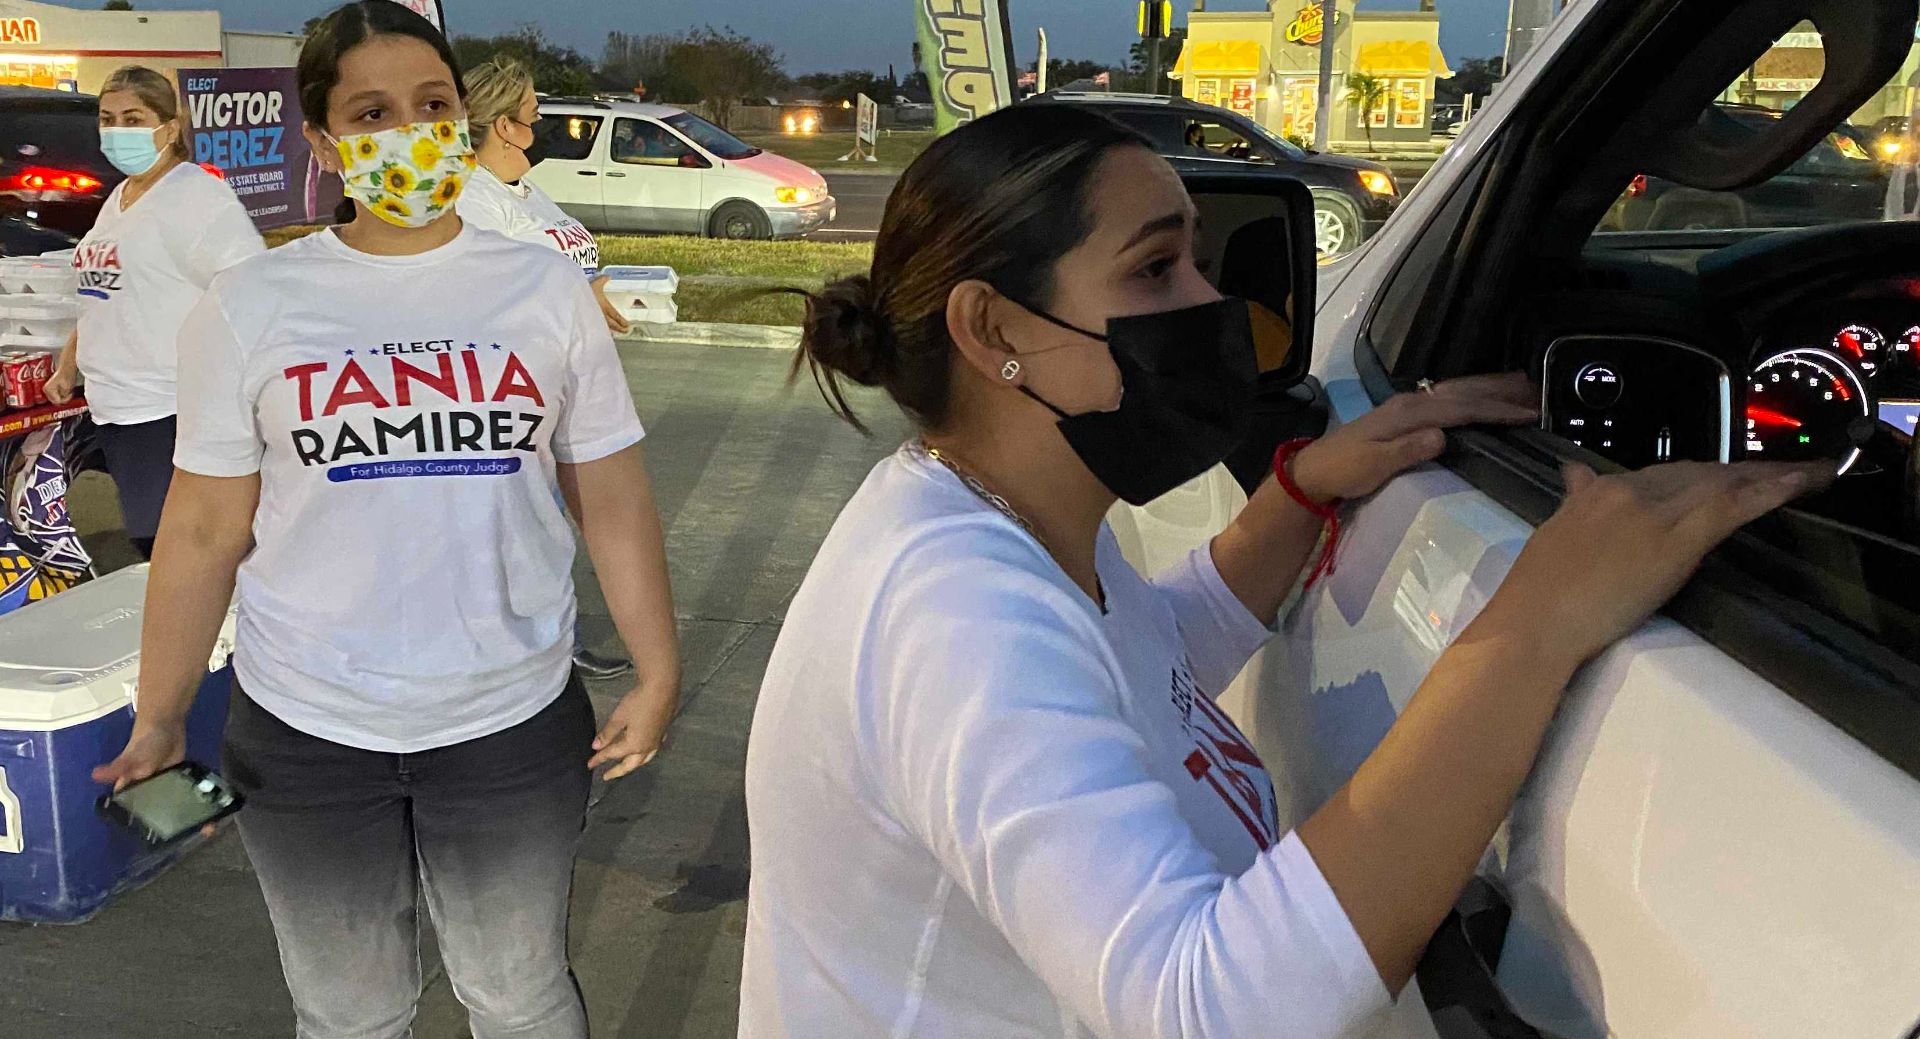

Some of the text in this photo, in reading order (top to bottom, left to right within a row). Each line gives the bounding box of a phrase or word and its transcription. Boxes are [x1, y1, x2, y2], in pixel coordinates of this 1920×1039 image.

[187, 78, 218, 91] ELECT
[188, 91, 283, 129] VICTOR
[194, 126, 285, 170] PEREZ
[236, 173, 258, 186] STATE
[259, 170, 284, 183] BOARD
[254, 183, 279, 193] DISTRICT
[281, 182, 285, 190] 2
[73, 246, 122, 270] ANIA
[382, 339, 454, 356] ELECT
[283, 349, 546, 422] TANIA
[1771, 373, 1780, 382] 3
[1791, 370, 1800, 379] 4
[1824, 391, 1833, 401] 6
[291, 410, 545, 467] RAMIREZ
[350, 461, 510, 478] For Hidalgo County Judge
